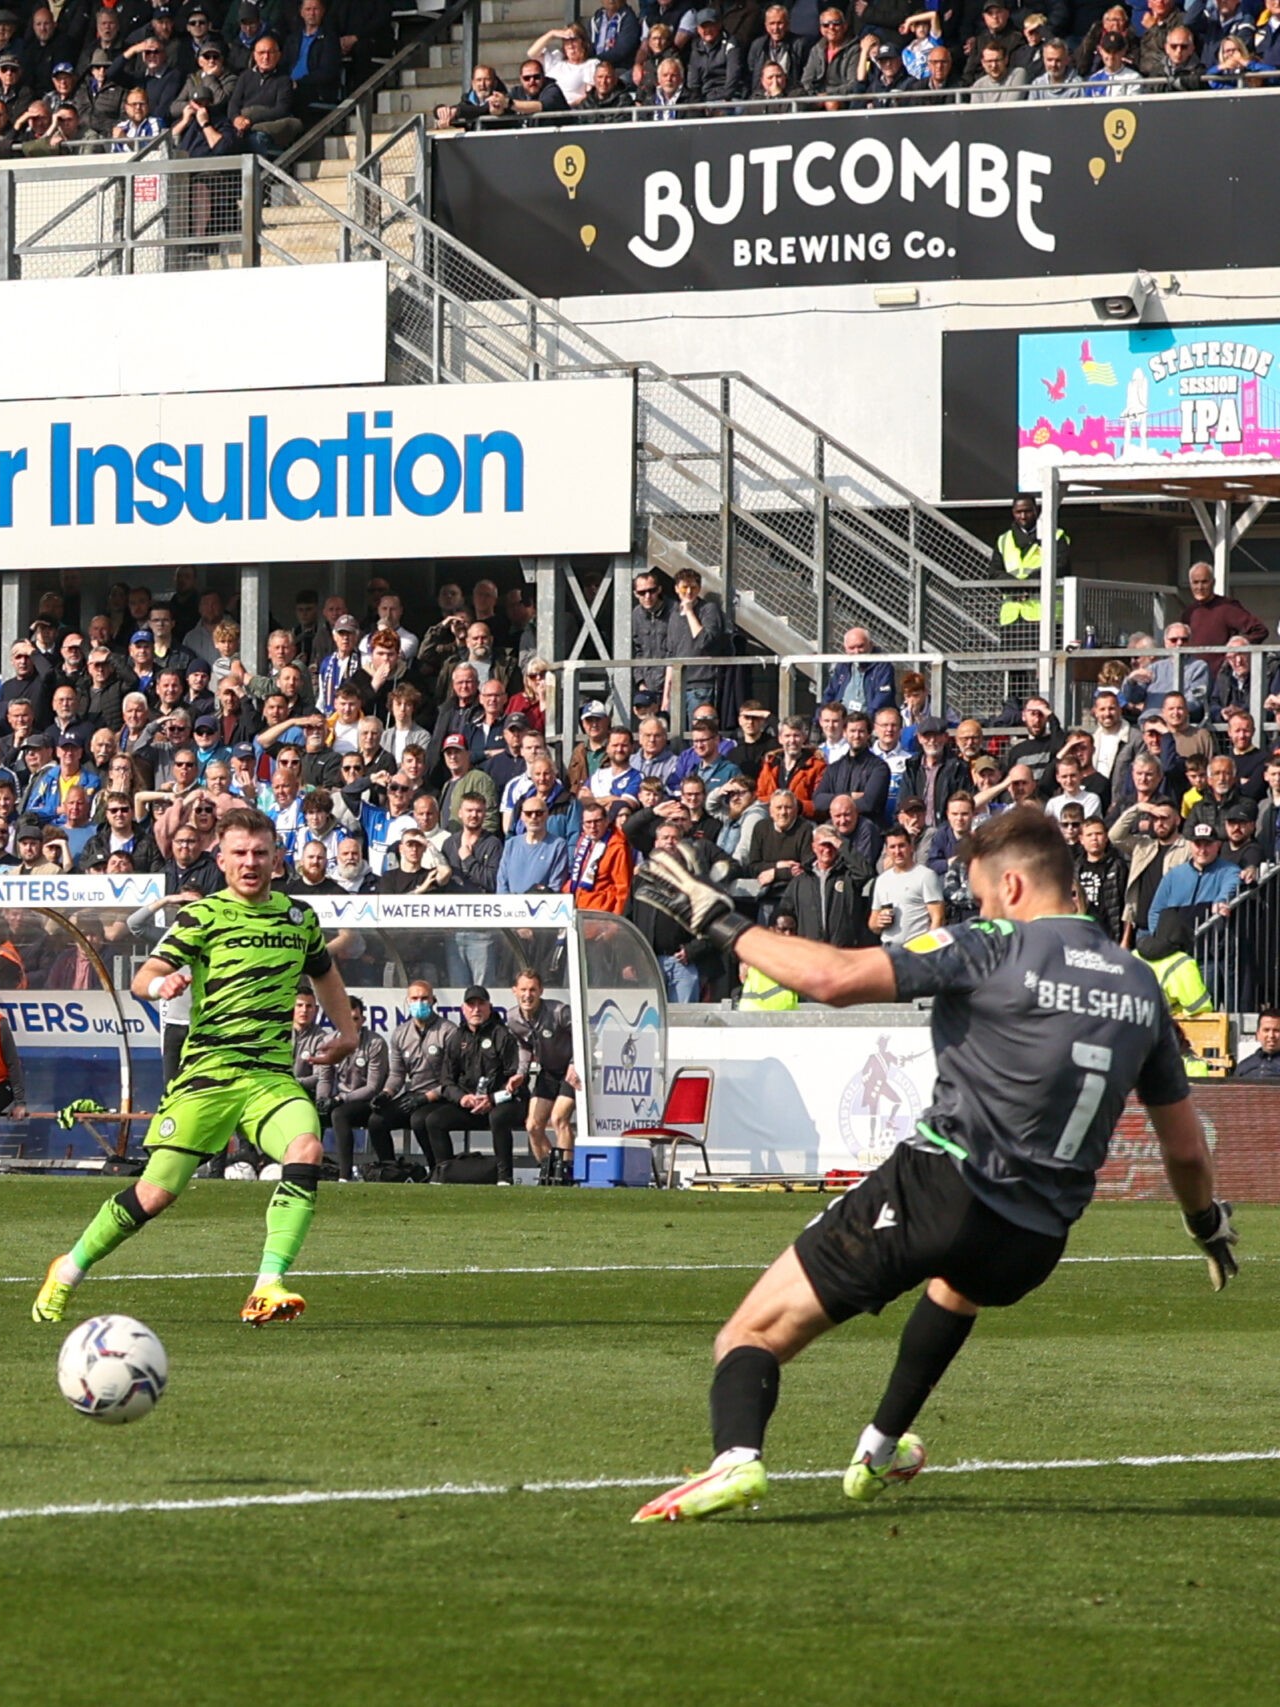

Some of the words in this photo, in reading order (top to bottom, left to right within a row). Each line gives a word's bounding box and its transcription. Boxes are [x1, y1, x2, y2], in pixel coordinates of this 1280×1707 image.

[400, 92, 412, 112] D
[1111, 119, 1128, 140] B
[562, 156, 578, 177] B
[627, 136, 1056, 268] BUTCOMBE
[732, 233, 892, 267] BREWING
[903, 230, 956, 260] Co.
[1148, 341, 1274, 383] STATESIDE
[1179, 375, 1239, 396] SESSION
[1180, 399, 1243, 445] IPA
[50, 411, 524, 526] Insulation
[72, 892, 85, 901] UK
[87, 891, 105, 901] LTD
[382, 904, 430, 917] WATER
[433, 903, 502, 917] MATTERS
[224, 931, 307, 954] ecotricity
[1036, 979, 1156, 1028] BELSHAW
[93, 1018, 114, 1033] UK
[605, 1068, 650, 1093] AWAY
[1053, 1041, 1113, 1161] 1
[595, 1119, 622, 1131] WATER
[623, 1119, 661, 1131] MATTERS
